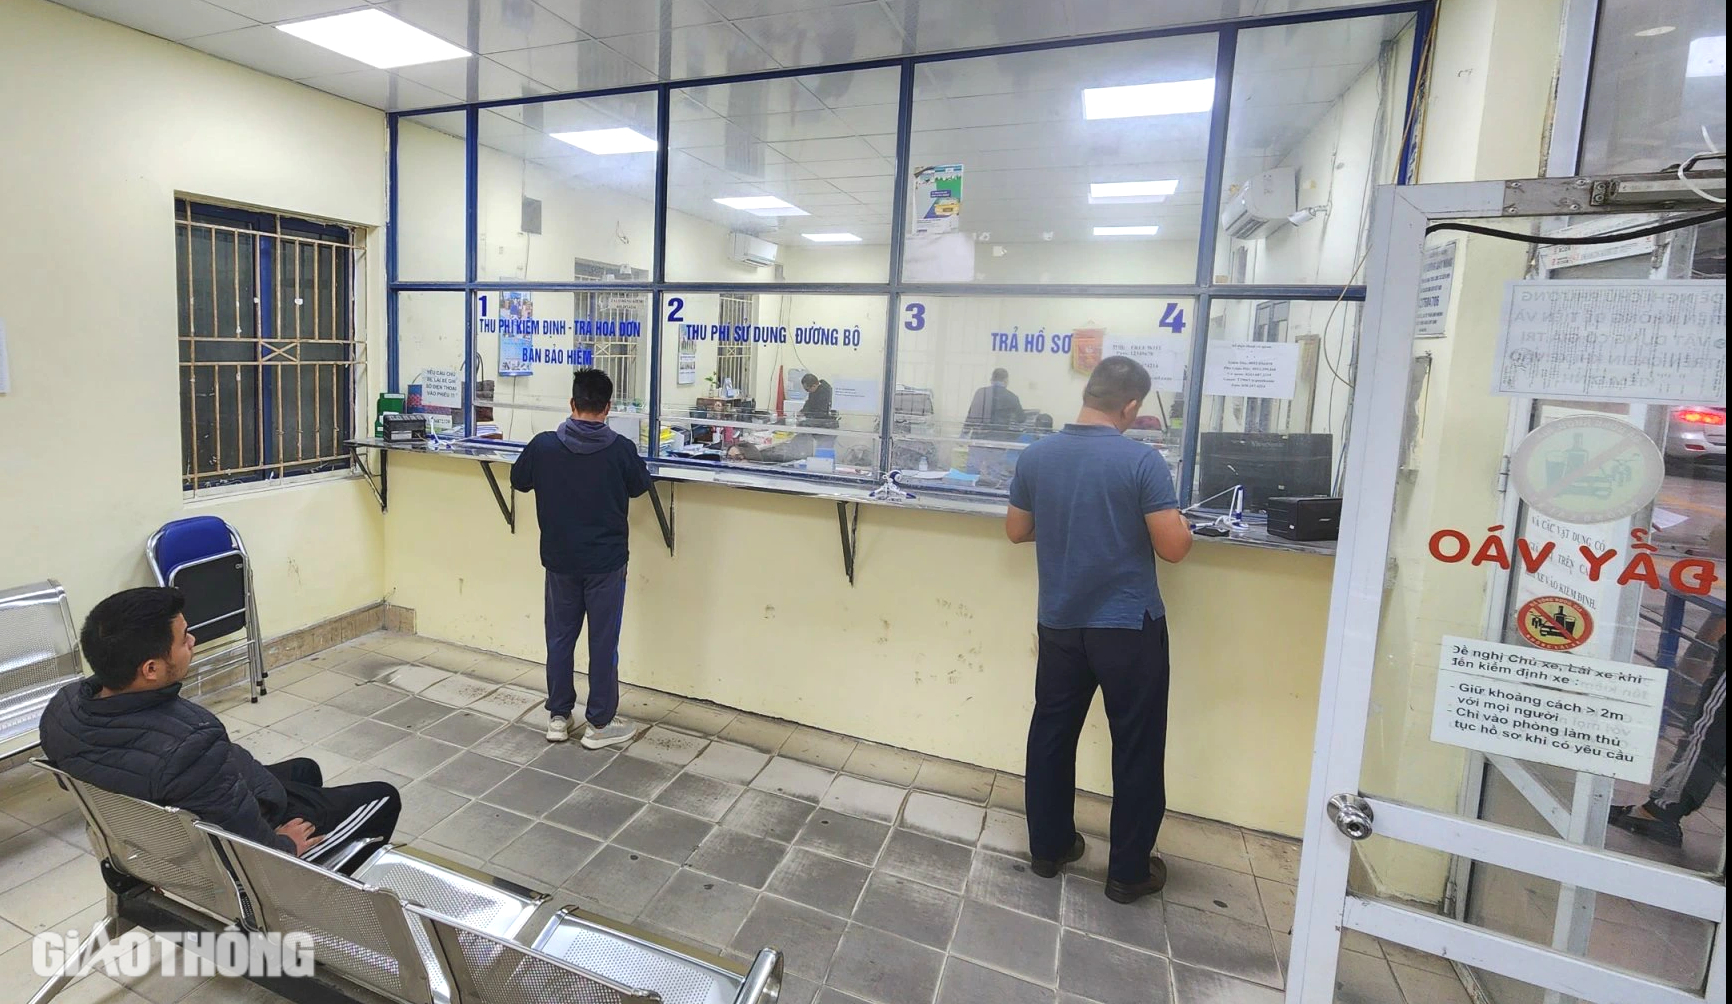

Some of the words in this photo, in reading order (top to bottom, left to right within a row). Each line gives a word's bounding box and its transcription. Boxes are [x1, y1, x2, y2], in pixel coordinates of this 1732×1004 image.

[478, 295, 487, 317] 1
[667, 297, 684, 322] 2
[904, 302, 926, 331] 3
[1158, 302, 1187, 334] 4
[480, 318, 496, 333] THU
[516, 312, 539, 335] KIỂM
[542, 320, 566, 338] ĐỊNH
[574, 313, 592, 336] TRẢ
[595, 317, 615, 337] HOÁ
[619, 320, 641, 337] ĐƠN
[686, 324, 707, 341] THU
[711, 321, 730, 342] PHÍ
[734, 317, 751, 342] SỬ
[753, 326, 787, 347] DỤNG
[795, 321, 839, 346] ĐƯỜNG
[843, 324, 861, 351] BỘ
[544, 343, 563, 365] BẢO
[566, 342, 592, 366] HIỂM
[991, 326, 1019, 352] TRẢ
[1024, 326, 1045, 353] HỒ
[1050, 333, 1074, 354] SƠ
[1473, 650, 1504, 663] nghị
[1508, 654, 1537, 667] Chủ
[1542, 660, 1562, 671] xe,
[1568, 664, 1591, 675] Lái
[1595, 670, 1613, 679] xe
[1619, 672, 1642, 684] khi
[1479, 661, 1512, 674] kiểm
[1516, 667, 1548, 680] định
[1552, 675, 1570, 684] xe
[1457, 696, 1480, 707] với
[1484, 702, 1510, 713] mọi
[1514, 707, 1559, 721] người
[1459, 683, 1485, 695] Giữ
[1489, 688, 1542, 708] khoảng
[1546, 699, 1582, 713] cách
[1600, 708, 1624, 721] 2m
[1455, 719, 1477, 731] tục
[1481, 724, 1498, 735] hồ
[1502, 730, 1522, 740] sơ
[1525, 733, 1547, 745] khi
[1552, 740, 1570, 750] có
[1575, 744, 1602, 756] yêu
[1606, 749, 1634, 762] cầu
[1456, 707, 1479, 720] Chỉ
[1483, 713, 1508, 725] vào
[1512, 719, 1559, 737] phòng
[1564, 727, 1591, 741] làm
[1596, 734, 1621, 747] thủ
